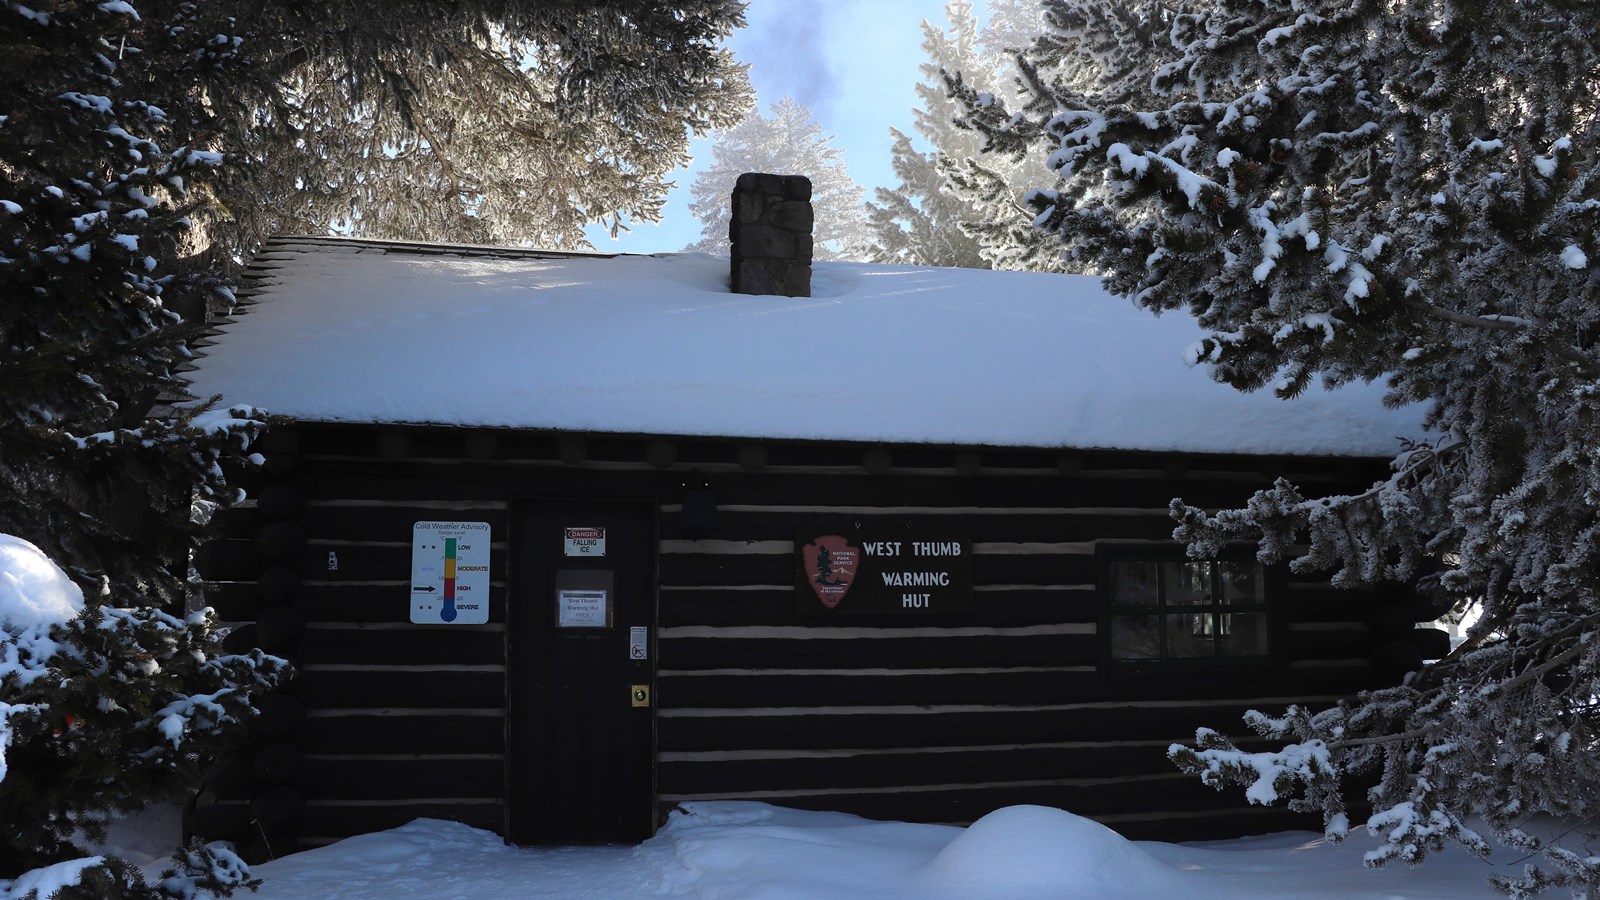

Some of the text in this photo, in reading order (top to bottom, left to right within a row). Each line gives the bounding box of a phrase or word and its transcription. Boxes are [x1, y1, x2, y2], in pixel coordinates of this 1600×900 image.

[415, 522, 489, 532] Cold Weather Advisory
[862, 541, 962, 556] WEST THUMB
[881, 572, 950, 586] WARMING
[902, 593, 931, 608] HUT
